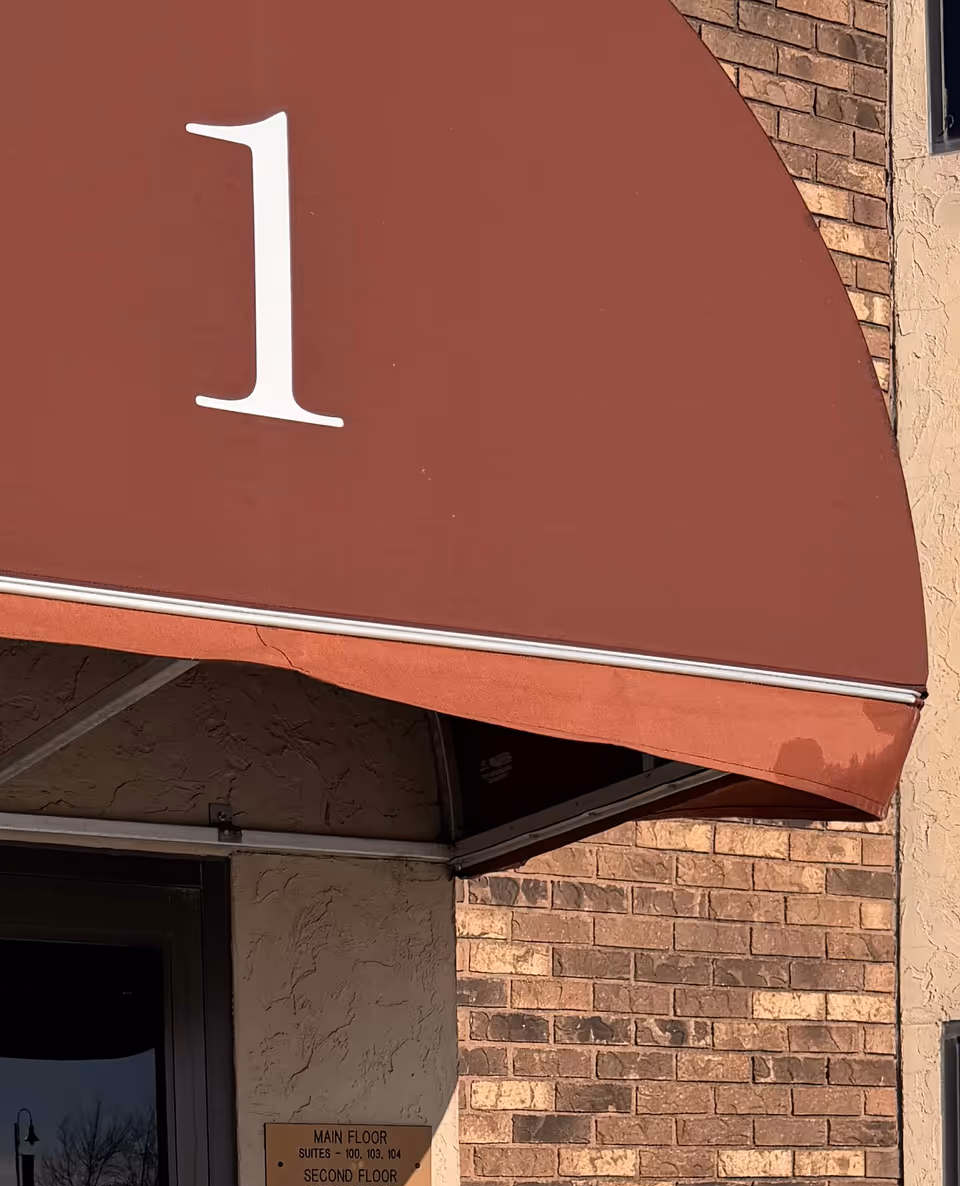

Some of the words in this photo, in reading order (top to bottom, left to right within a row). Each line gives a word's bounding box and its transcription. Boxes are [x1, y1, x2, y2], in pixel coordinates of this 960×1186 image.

[185, 110, 344, 427] 1
[313, 1130, 343, 1144] MAIN
[348, 1130, 388, 1144] FLOOR
[298, 1148, 331, 1159] SUITES
[388, 1148, 402, 1160] 104
[303, 1168, 353, 1182] SECOND
[358, 1168, 397, 1183] FLOOR
